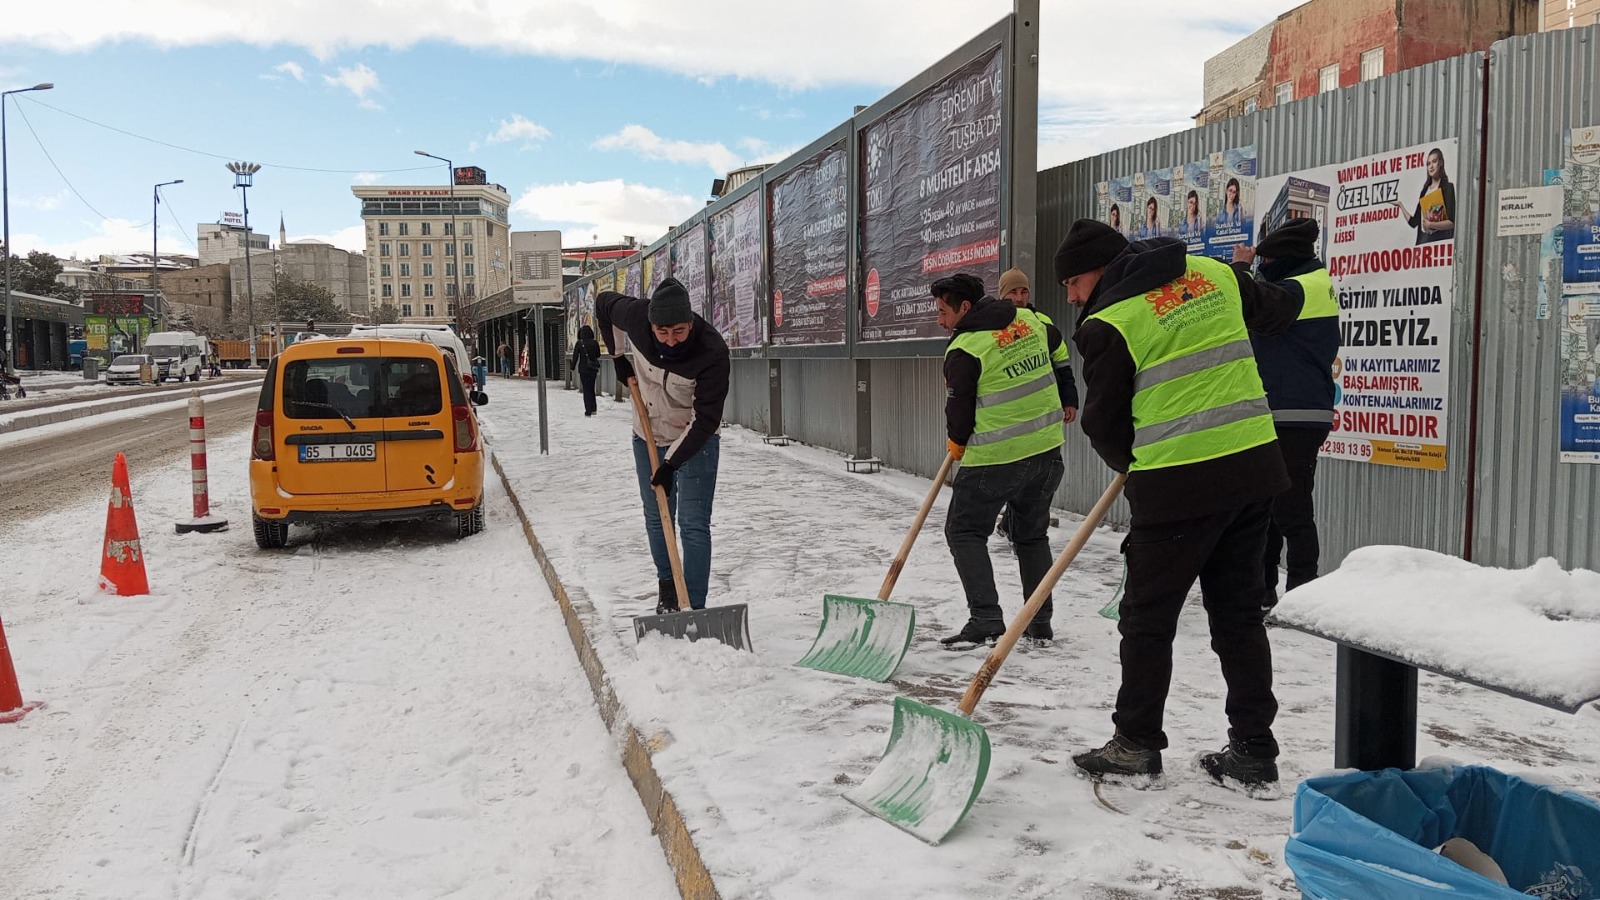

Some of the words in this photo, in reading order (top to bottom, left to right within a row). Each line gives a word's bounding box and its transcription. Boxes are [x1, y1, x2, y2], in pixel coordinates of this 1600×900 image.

[942, 77, 987, 121] EDREMİT
[989, 69, 1001, 97] VE
[920, 179, 925, 198] 8
[927, 157, 972, 196] MUHTELİF
[973, 148, 1000, 179] ARSA
[1338, 164, 1368, 184] VAN'DA
[1371, 158, 1387, 176] İLK
[1390, 156, 1402, 172] VE
[1406, 152, 1425, 170] TEK
[1336, 184, 1370, 211] ÖZEL
[1372, 179, 1400, 206] KIZ
[1336, 216, 1348, 228] FEN
[1350, 212, 1358, 225] VE
[1360, 206, 1400, 224] ANADOLU
[1334, 226, 1355, 244] LİSESİ
[1339, 286, 1378, 310] ĞİTİM
[1383, 286, 1442, 308] YILINDA
[1003, 348, 1048, 379] TEMİZLİK
[1345, 356, 1358, 372] ÖN
[1360, 359, 1440, 373] KAYITLARIMIZ
[1344, 376, 1422, 394] BAŞLAMIŞTIR.
[1343, 394, 1442, 410] KONTENJANLARIMIZ
[1343, 410, 1438, 438] SINIRLIDIR
[306, 446, 319, 458] 65
[330, 446, 336, 457] T
[346, 445, 373, 457] 0405
[1320, 440, 1331, 452] 32
[1332, 441, 1345, 454] 393
[1348, 443, 1358, 456] 13
[1360, 444, 1371, 457] 95
